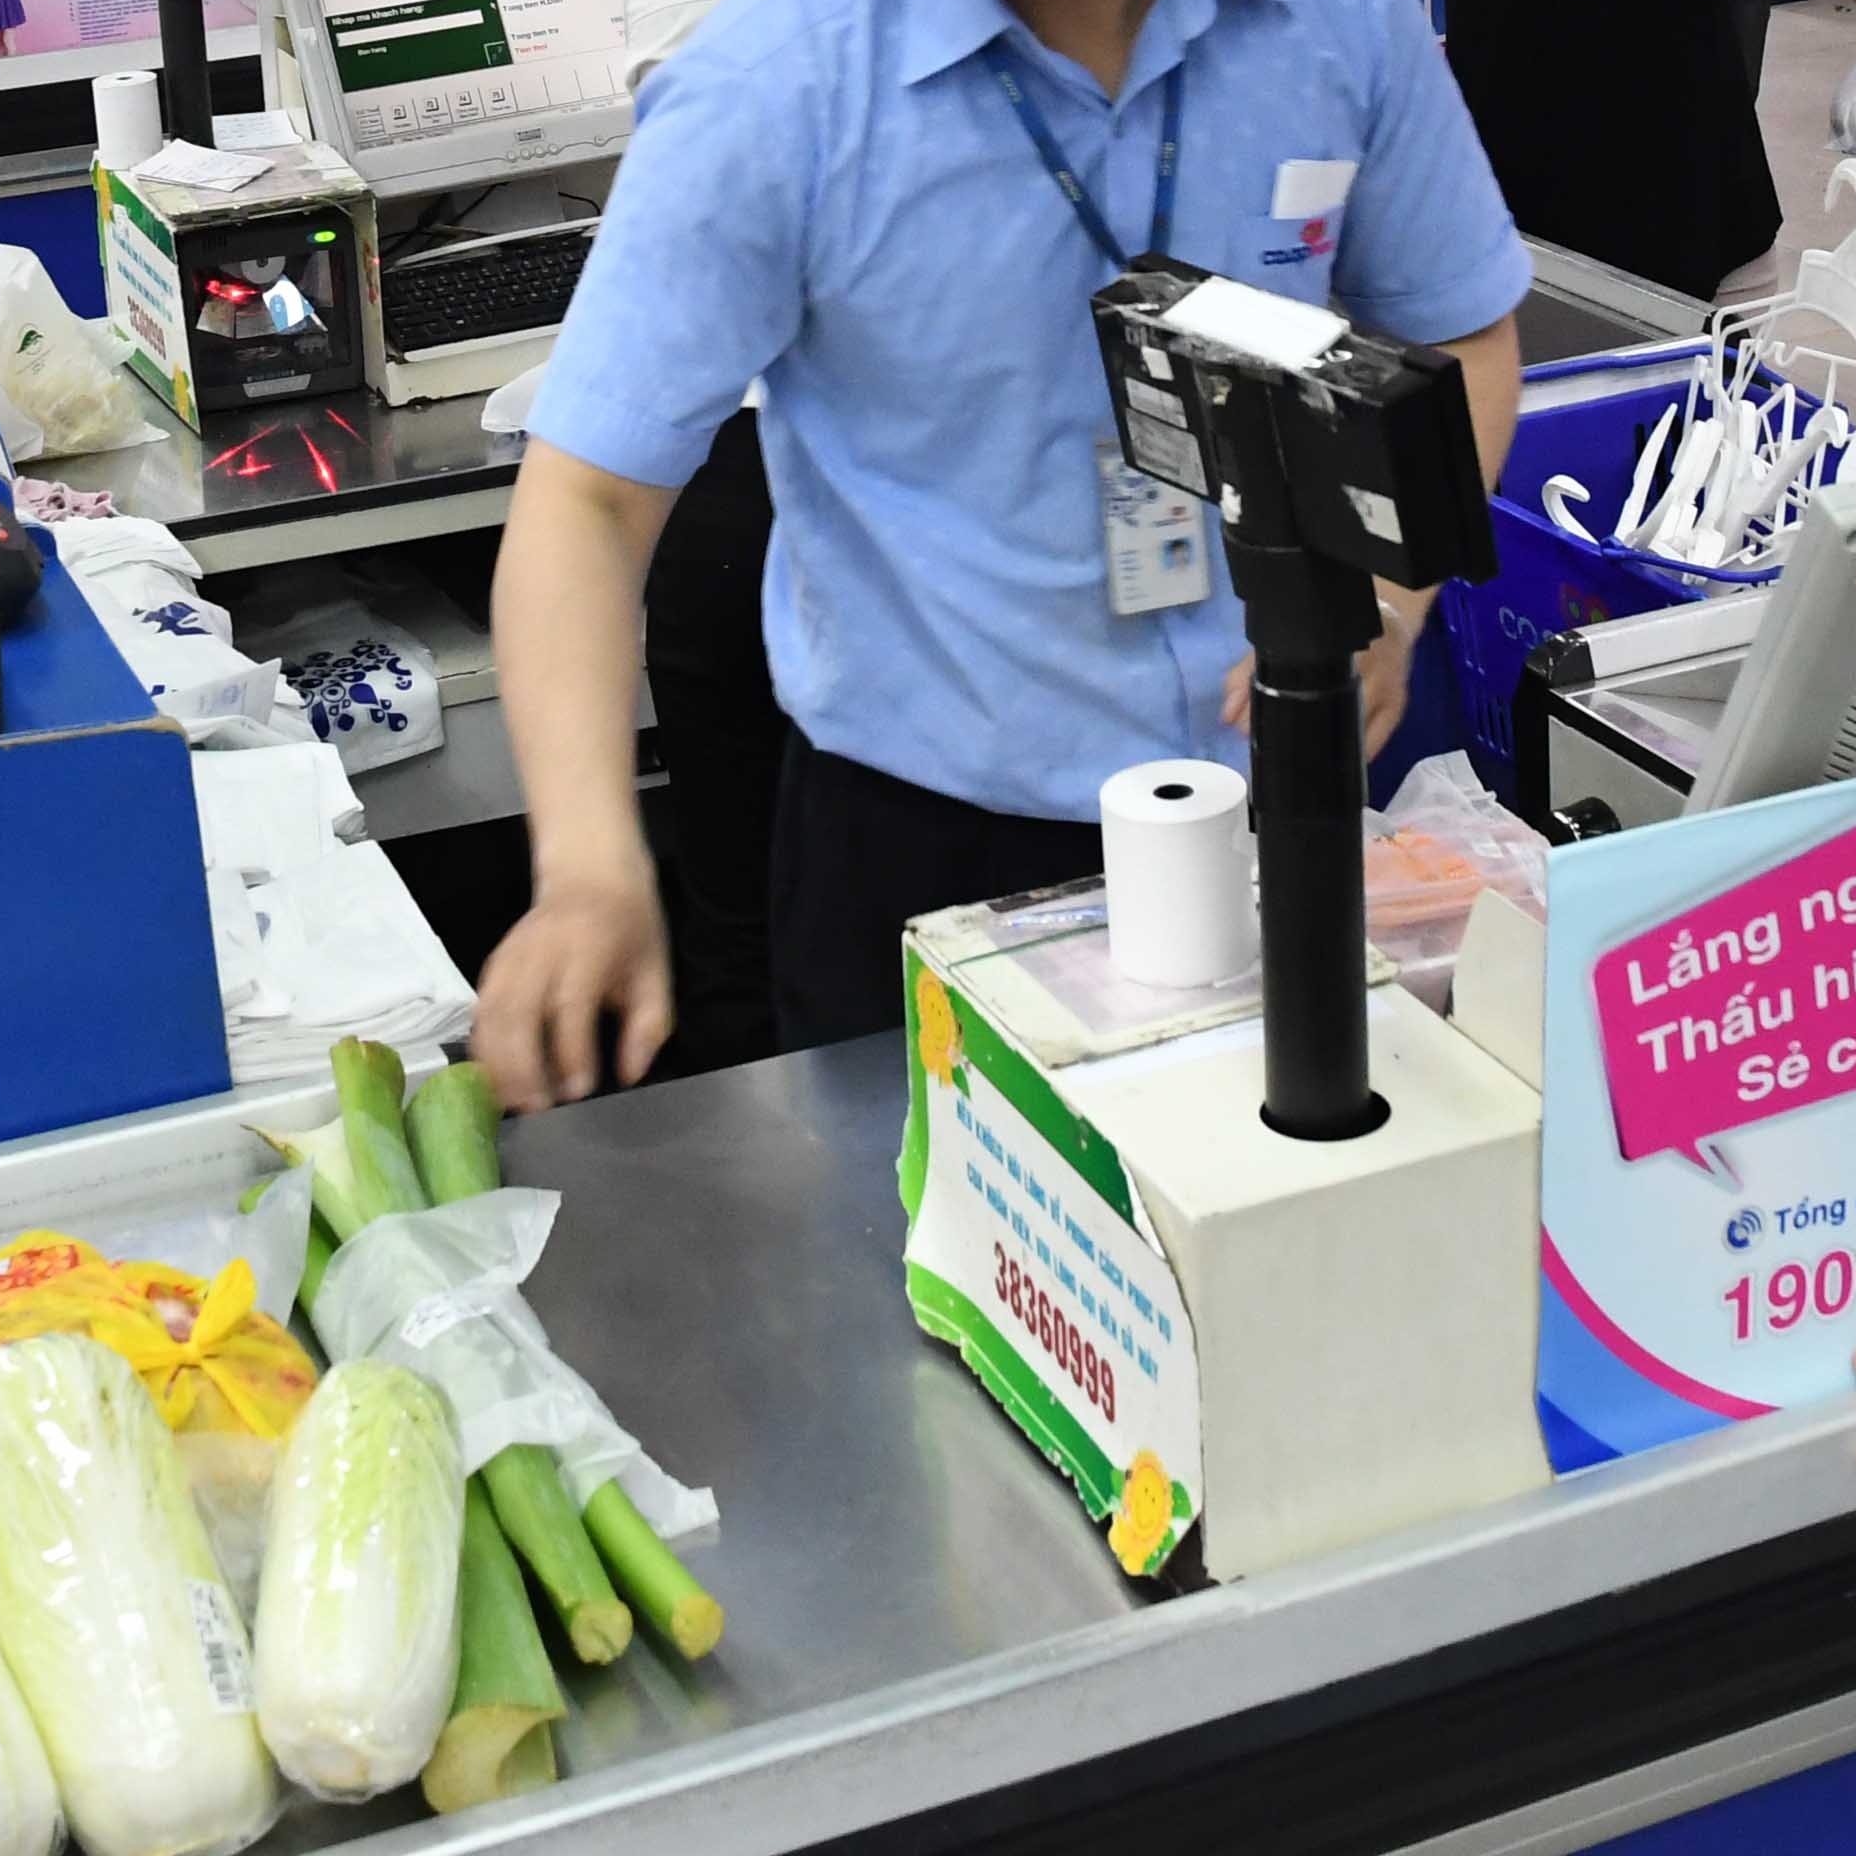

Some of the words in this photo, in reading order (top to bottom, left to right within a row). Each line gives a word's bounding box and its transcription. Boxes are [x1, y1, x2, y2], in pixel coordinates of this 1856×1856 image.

[1626, 908, 1783, 1008] Lắng
[1636, 986, 1797, 1078] Thấu
[1735, 1033, 1811, 1105] Sẻ
[1772, 1186, 1847, 1236] Tổng
[993, 1240, 1117, 1425] 38360999
